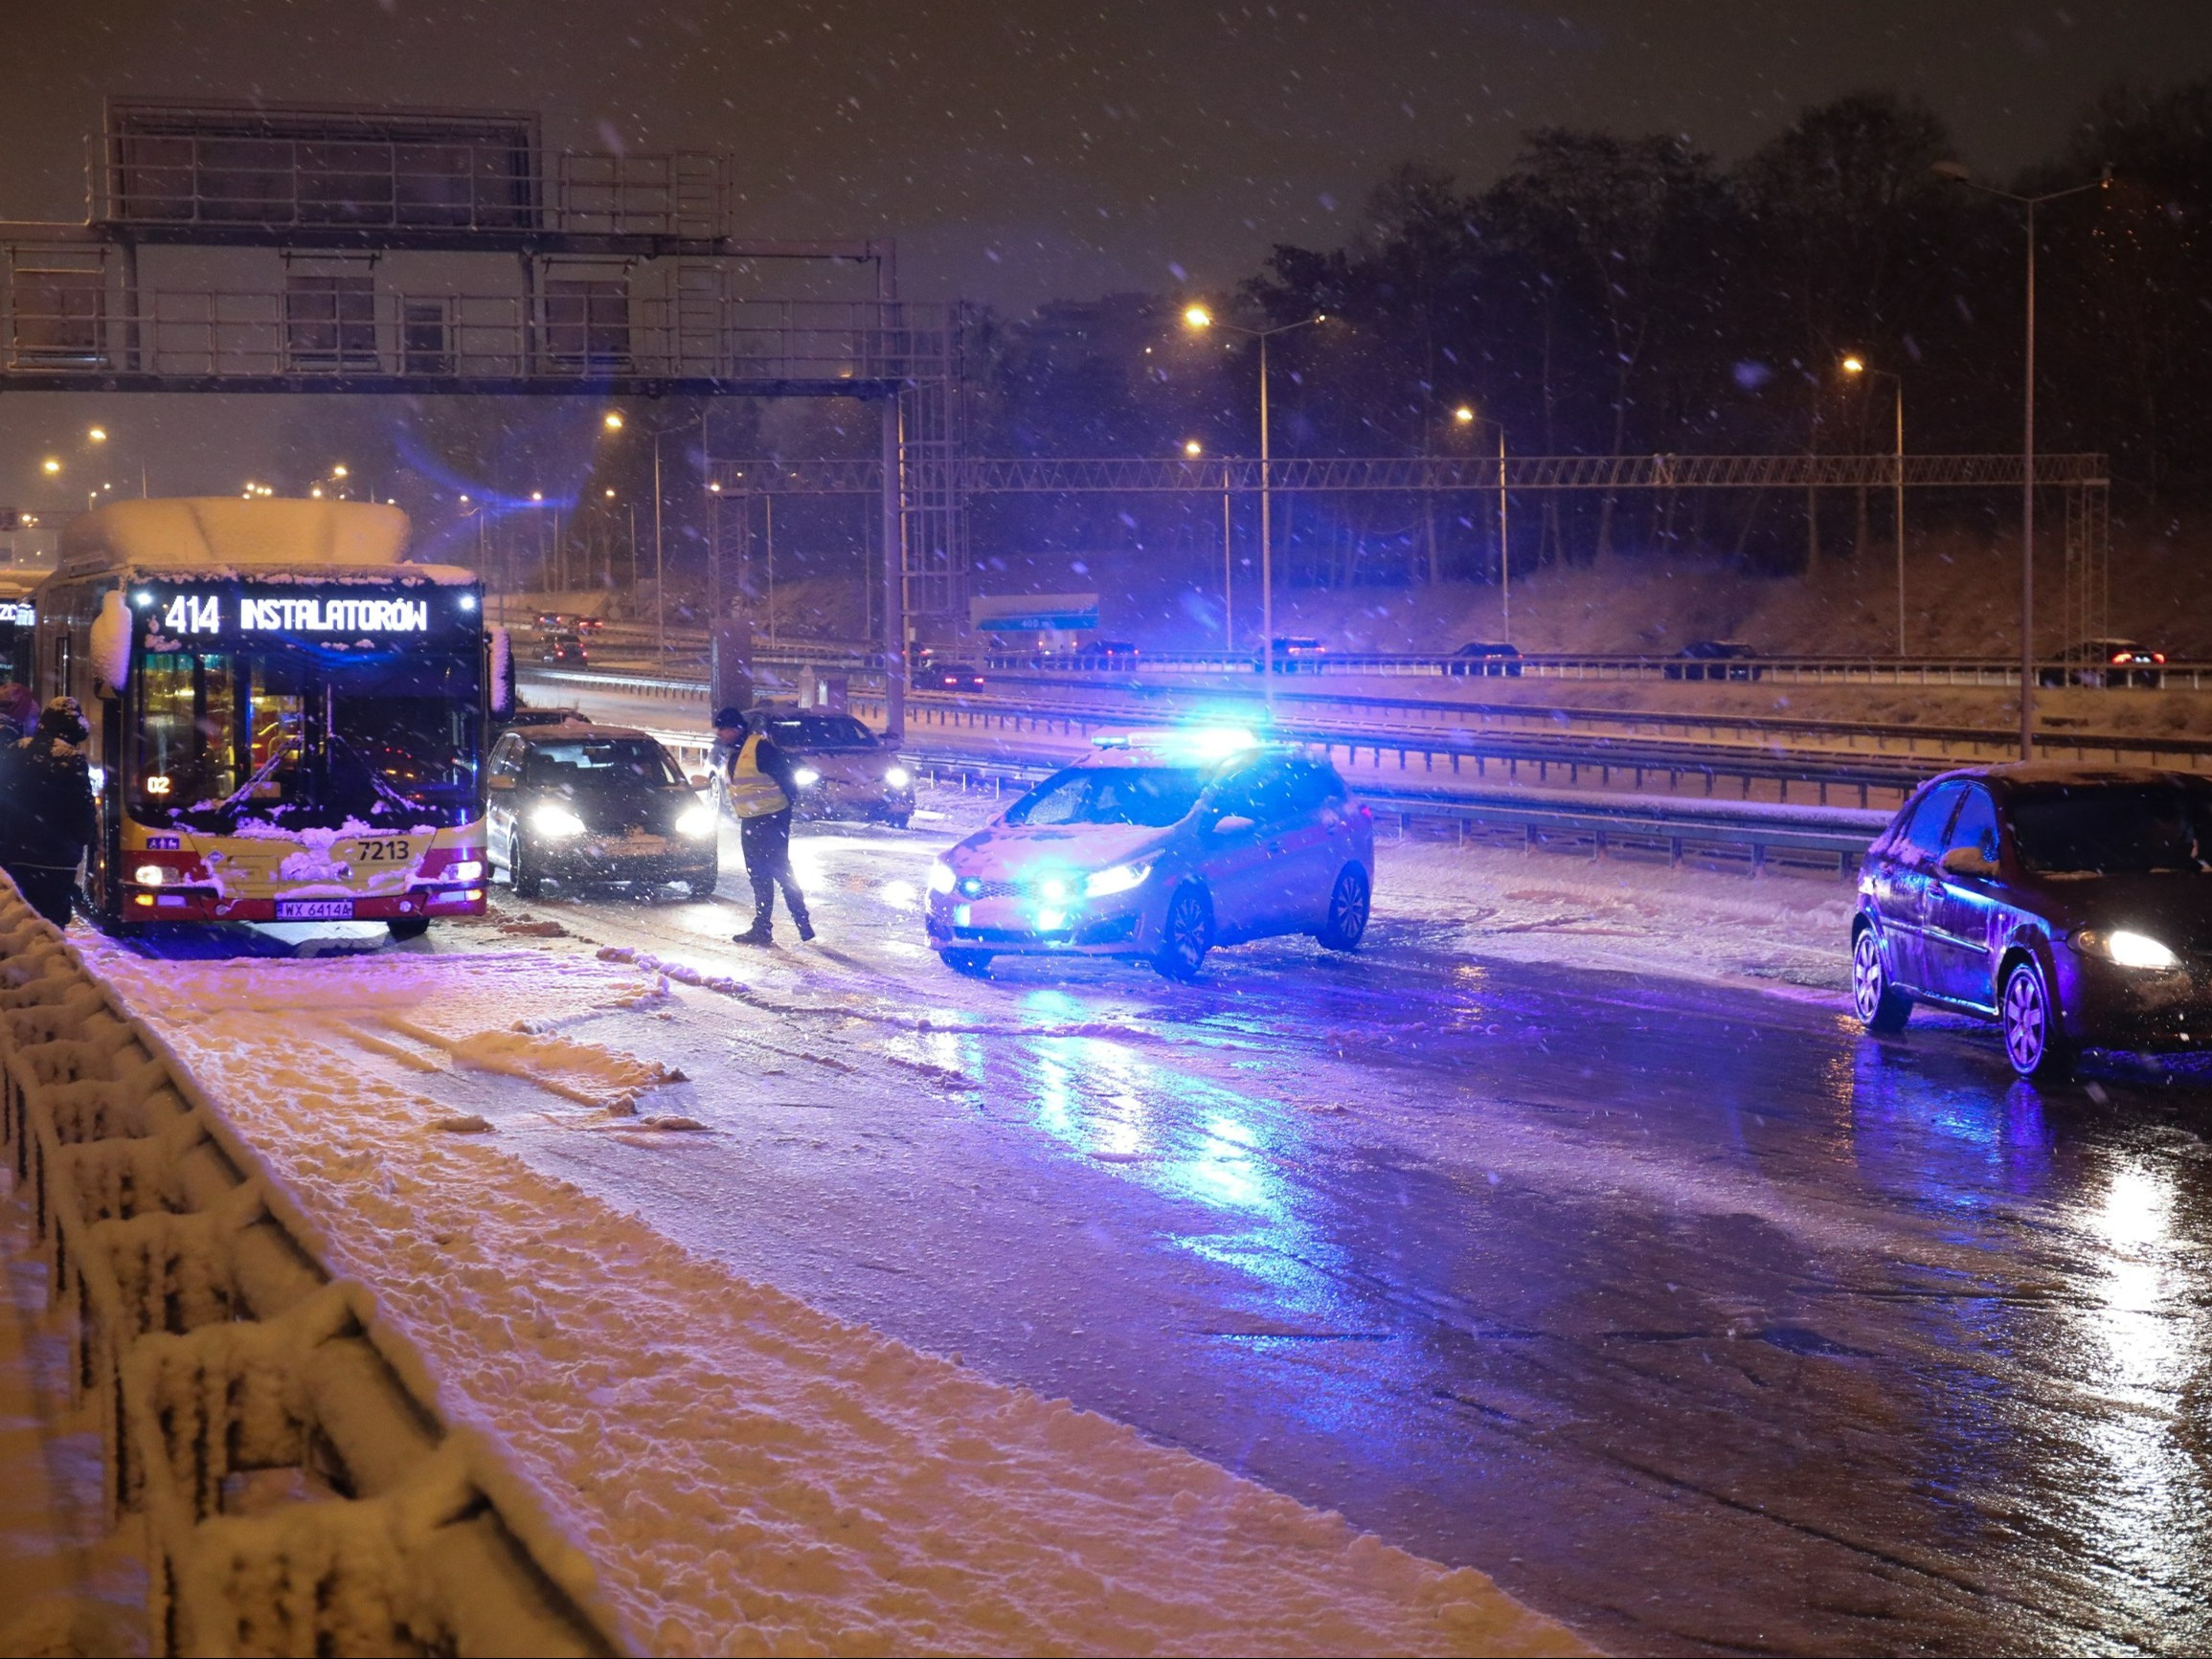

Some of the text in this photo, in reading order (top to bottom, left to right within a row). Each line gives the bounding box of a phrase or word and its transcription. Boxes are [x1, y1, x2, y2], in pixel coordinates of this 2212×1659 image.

[165, 595, 427, 633] 414 INSTALATORÓW
[147, 776, 170, 794] 02
[358, 841, 409, 861] 7213
[285, 904, 304, 916] WX
